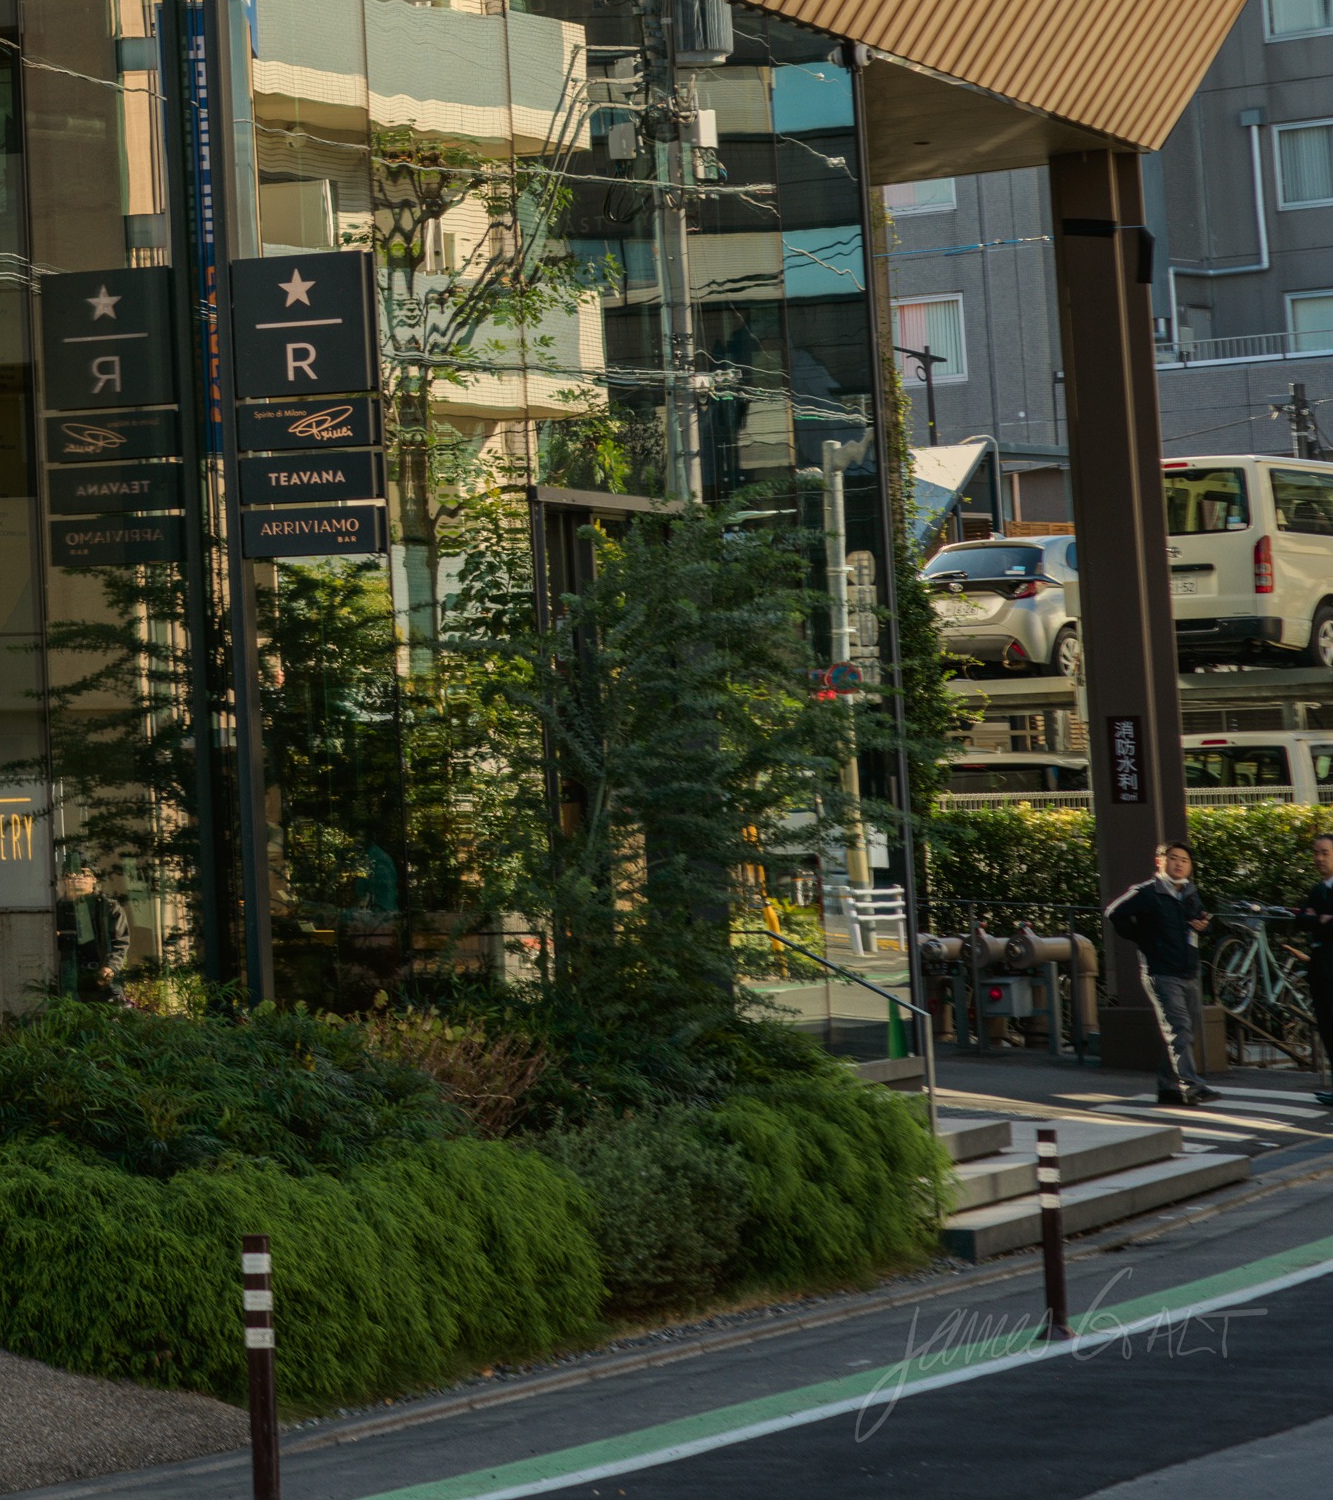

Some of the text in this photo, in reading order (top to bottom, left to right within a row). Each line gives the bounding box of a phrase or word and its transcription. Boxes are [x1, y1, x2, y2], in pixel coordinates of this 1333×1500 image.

[287, 342, 319, 381] R
[254, 409, 307, 420] Spirito di Milano
[268, 470, 346, 486] TEAVANA
[260, 518, 360, 536] ARRIVIAMO
[1114, 720, 1139, 790] 消防水利
